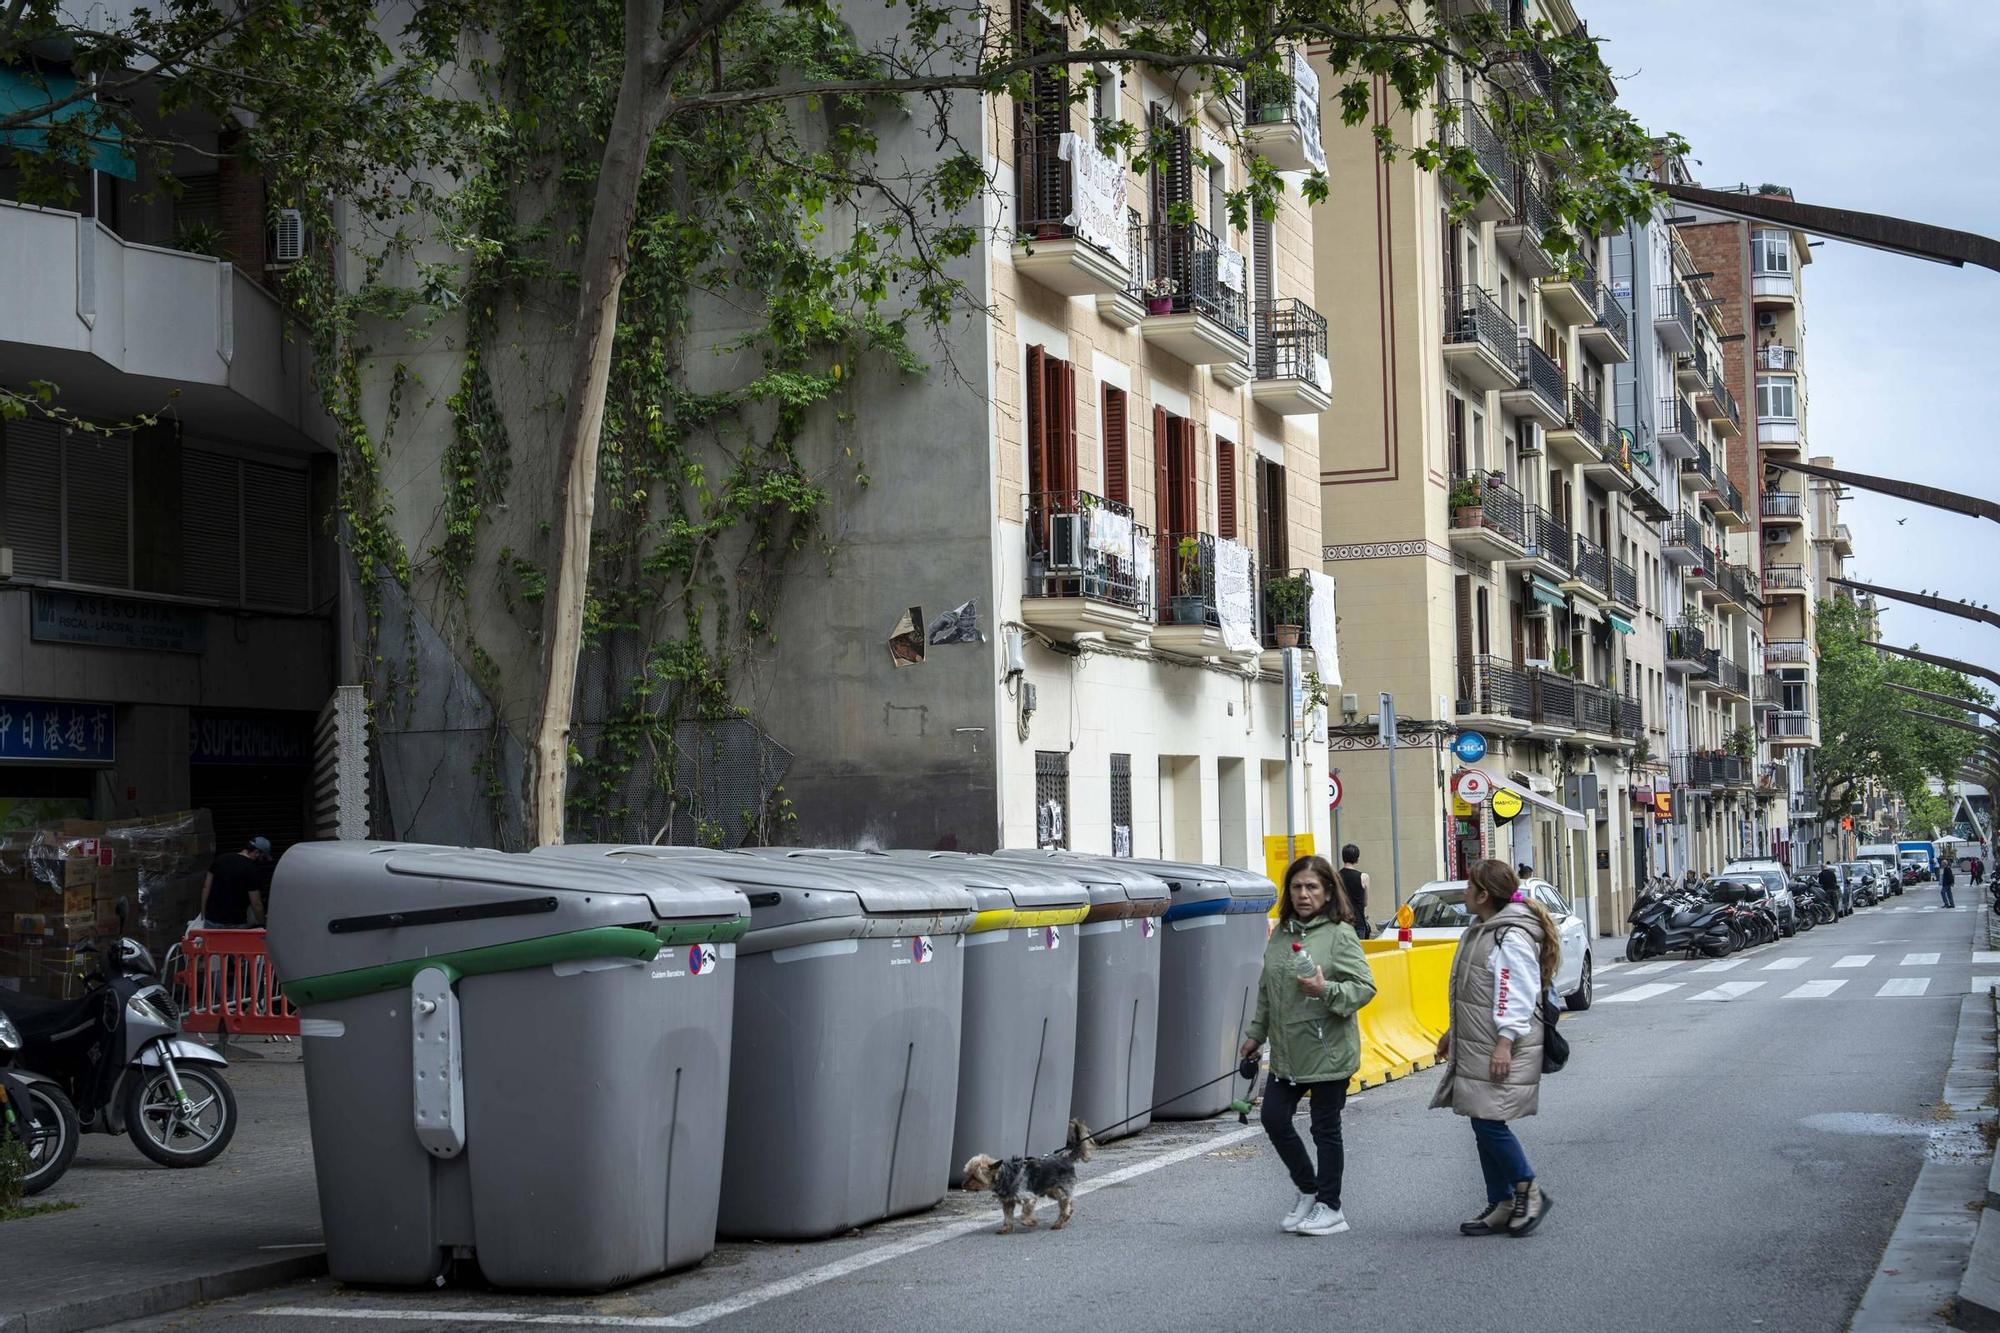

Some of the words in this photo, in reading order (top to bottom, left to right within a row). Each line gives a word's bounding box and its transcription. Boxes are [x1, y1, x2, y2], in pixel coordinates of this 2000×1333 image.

[1457, 744, 1484, 752] DIGI
[1329, 784, 1336, 797] 0
[1497, 968, 1510, 1017] Mafalda
